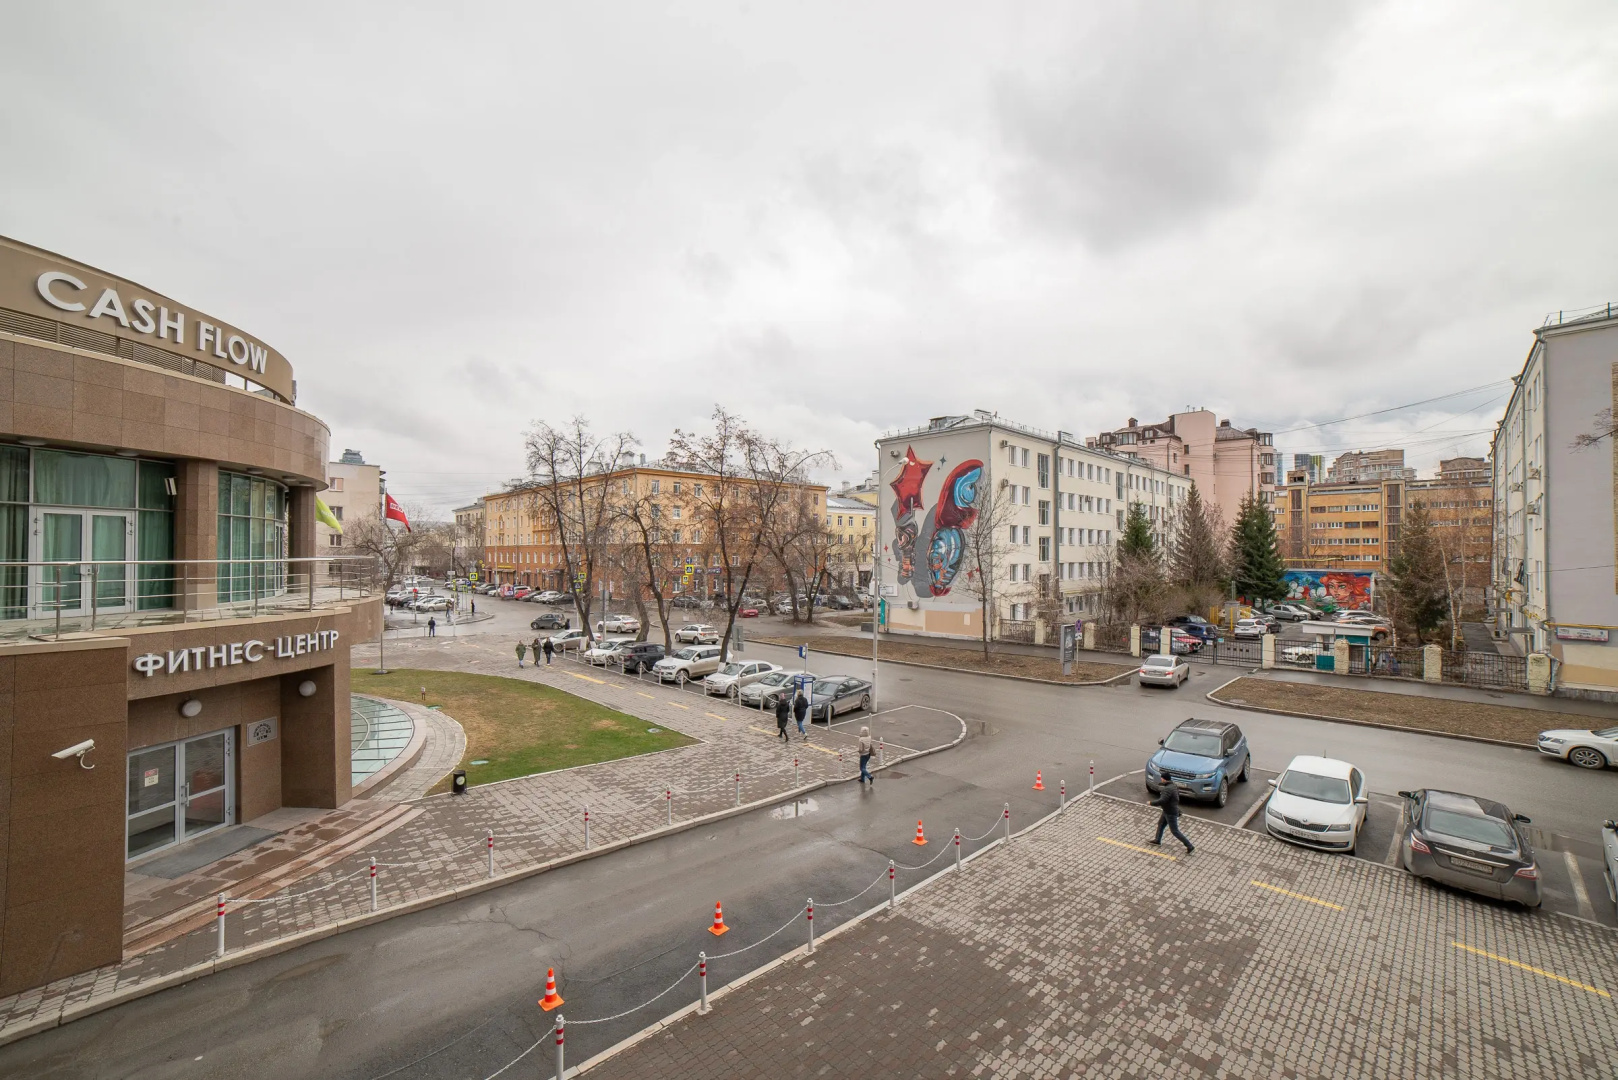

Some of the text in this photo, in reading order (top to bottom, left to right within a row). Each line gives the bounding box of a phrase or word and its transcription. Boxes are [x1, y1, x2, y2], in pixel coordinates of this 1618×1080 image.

[36, 271, 268, 375] CASH FLOW
[133, 630, 339, 678] ФИТНЕС-ЦЕНТР
